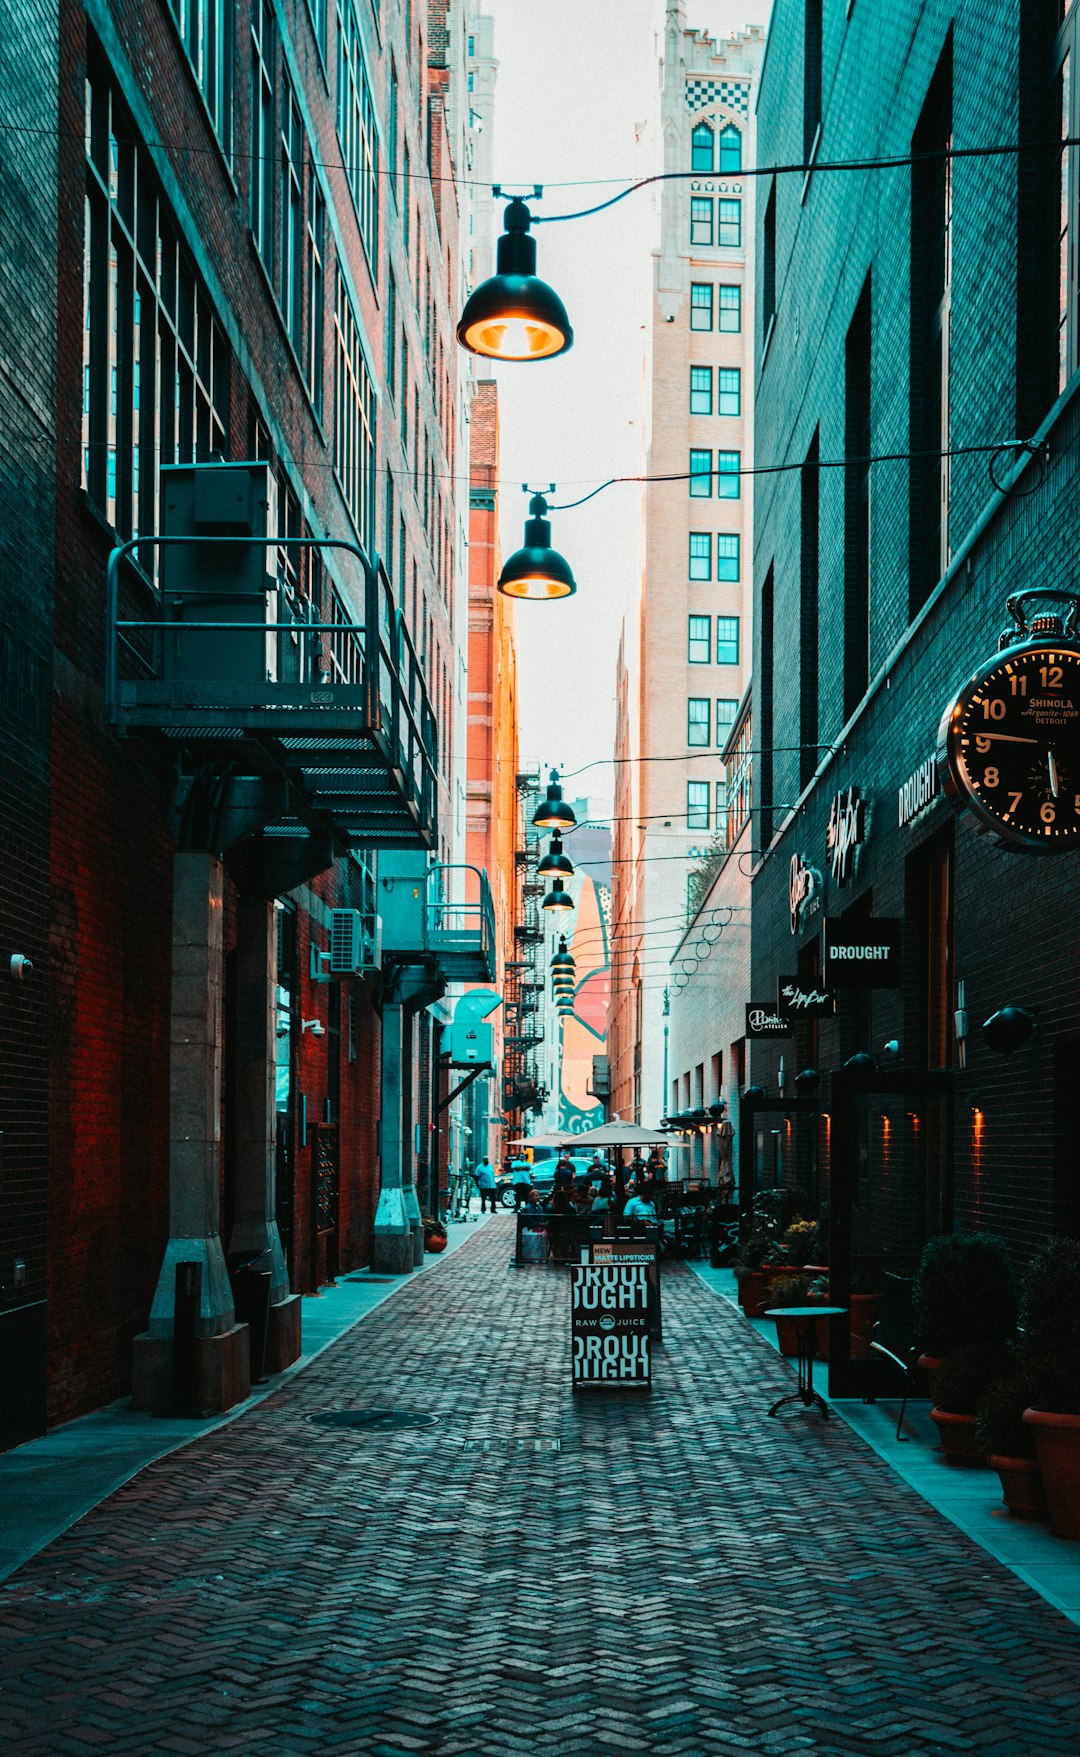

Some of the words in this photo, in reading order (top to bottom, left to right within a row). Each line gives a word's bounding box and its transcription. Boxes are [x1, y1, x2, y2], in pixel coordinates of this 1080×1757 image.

[1009, 675, 1027, 696] 11
[1039, 666, 1063, 688] 12
[313, 692, 331, 702] 829
[1029, 698, 1073, 709] SHINOLA
[981, 699, 1006, 720] 10
[1035, 717, 1067, 725] DETROIT
[983, 766, 999, 788] 8
[898, 752, 936, 828] DROUGHT
[1007, 792, 1023, 813] 7
[1040, 801, 1056, 824] 6
[830, 945, 890, 960] DROUGHT
[748, 1009, 782, 1031] Posie
[575, 1319, 597, 1327] RAW
[617, 1318, 646, 1326] JUICE
